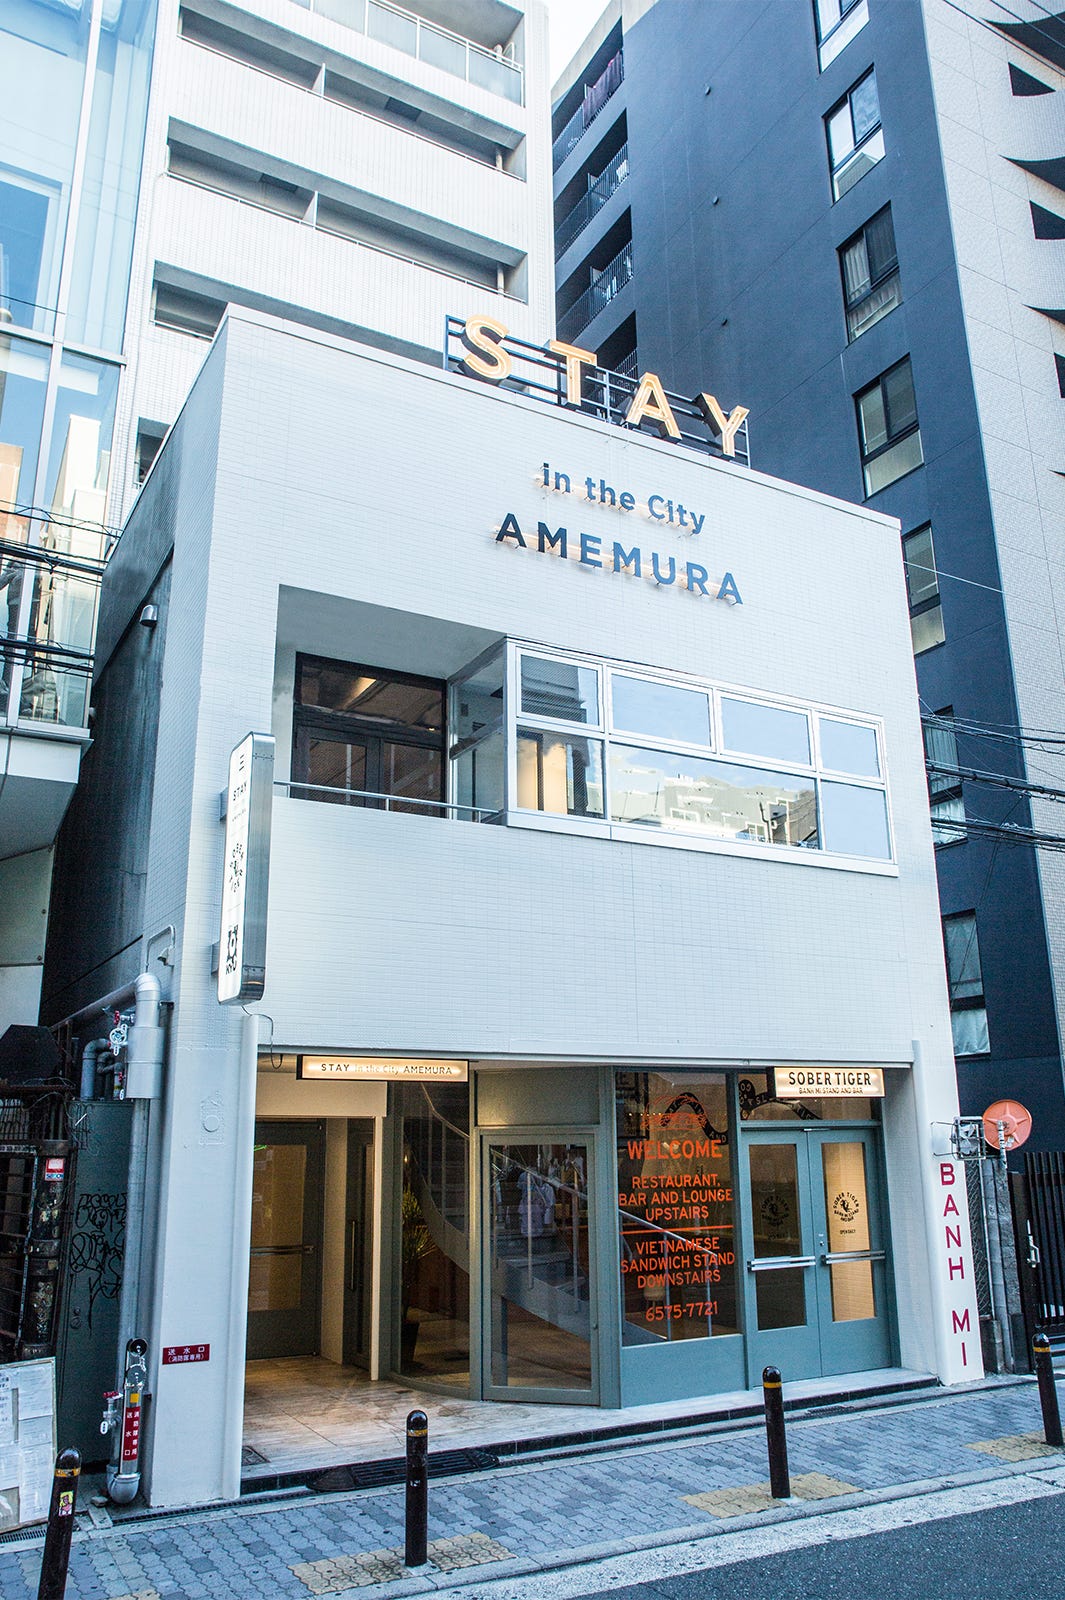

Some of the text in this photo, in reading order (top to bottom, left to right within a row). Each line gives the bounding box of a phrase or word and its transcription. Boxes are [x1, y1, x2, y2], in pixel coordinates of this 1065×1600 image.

[458, 314, 750, 459] STAY
[541, 462, 706, 536] in the City
[495, 512, 744, 606] AMEMURA
[321, 1063, 350, 1072] STAY
[403, 1065, 452, 1075] AMEMURA
[788, 1071, 871, 1086] SOBER TIGER
[627, 1139, 723, 1160] WELCOME
[619, 1188, 733, 1207] BAR AND LOUNGE
[645, 1205, 709, 1221] UPSTAIRS
[635, 1236, 720, 1255] VIETNAMESE
[620, 1252, 735, 1274] SANDWICH STAND
[939, 1162, 971, 1366] BANH MI
[637, 1269, 721, 1290] DOWNSTAIRS
[645, 1300, 718, 1322] 6575-7721
[168, 1346, 205, 1356] 送水口
